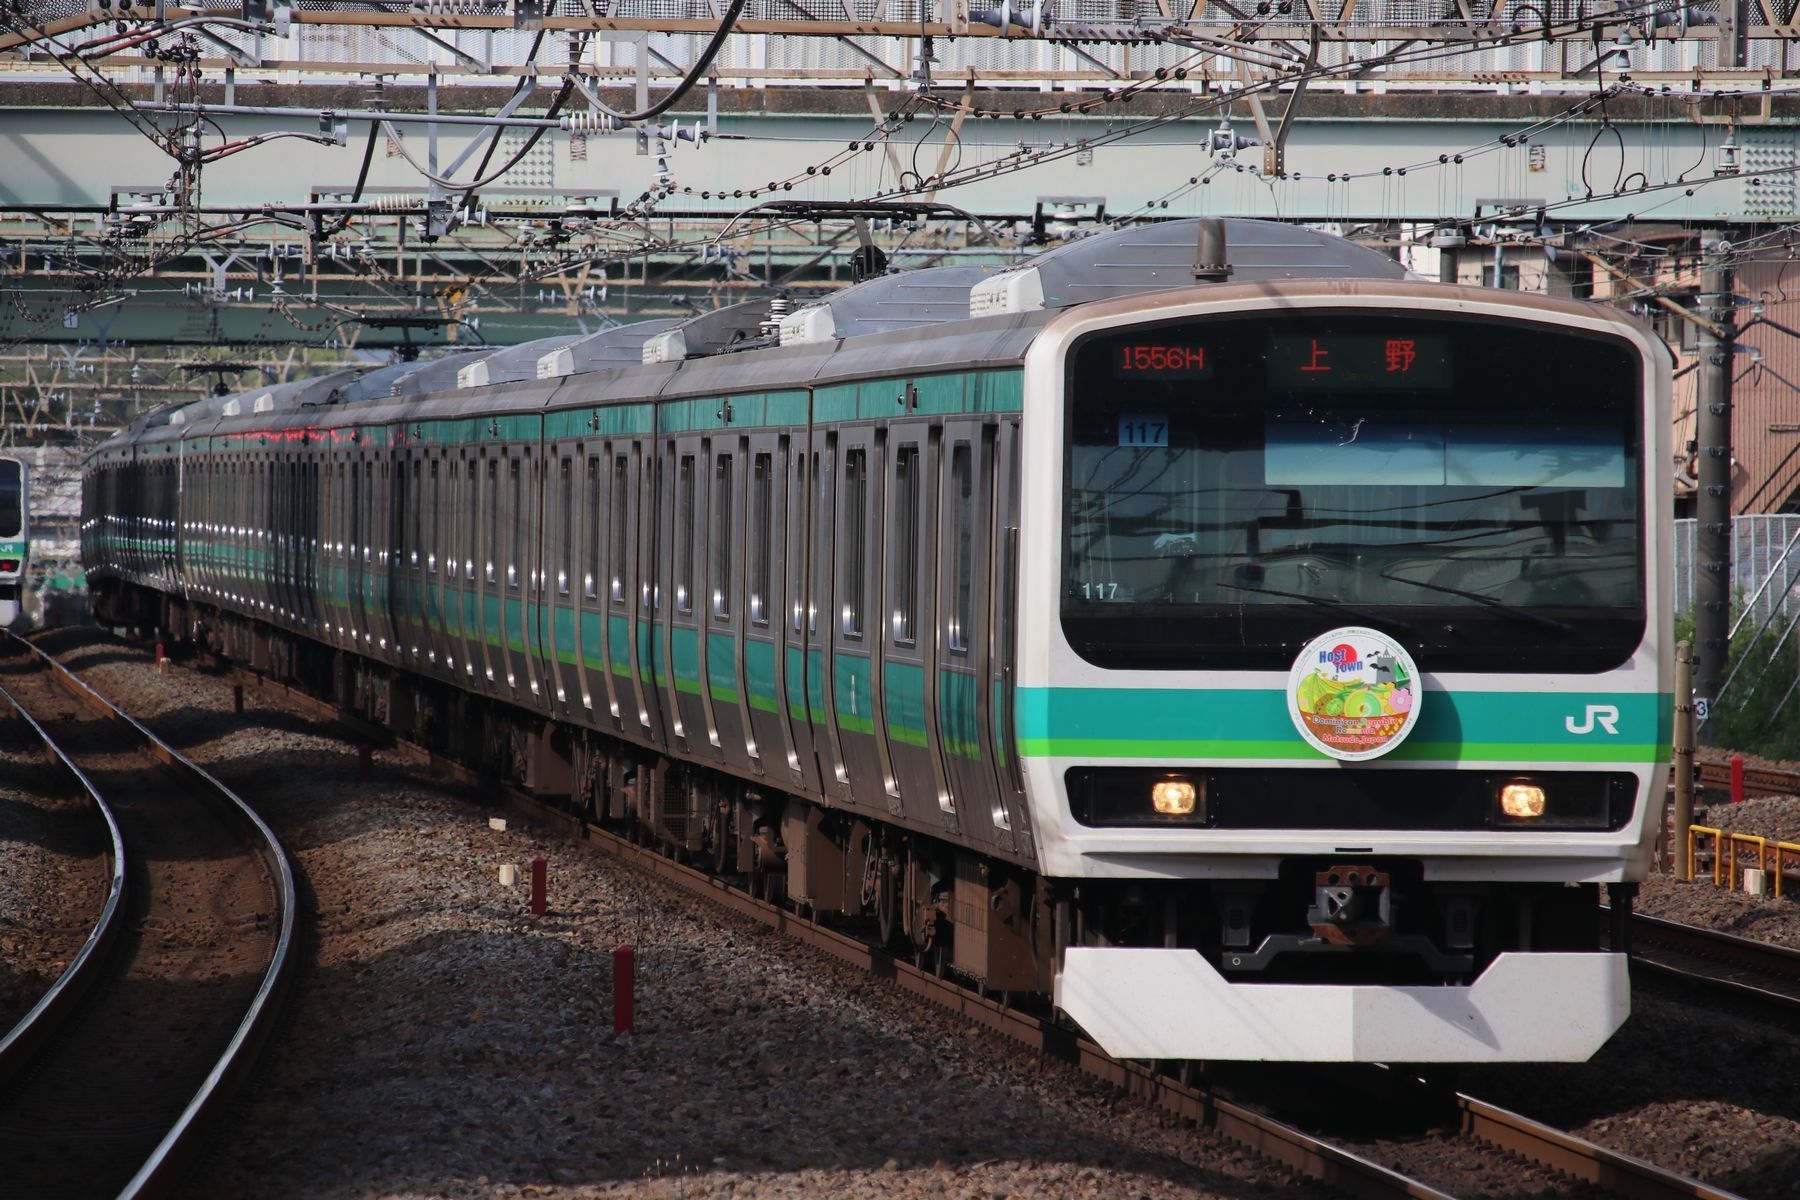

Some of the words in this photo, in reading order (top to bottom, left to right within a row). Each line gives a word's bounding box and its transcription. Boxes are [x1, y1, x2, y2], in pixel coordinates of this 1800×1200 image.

[1121, 346, 1204, 370] 1556H
[1125, 422, 1165, 443] 117
[1082, 583, 1118, 600] 117
[1319, 649, 1345, 663] Host
[1335, 661, 1363, 673] Town
[1312, 715, 1358, 725] Dominican
[1565, 705, 1619, 734] JR
